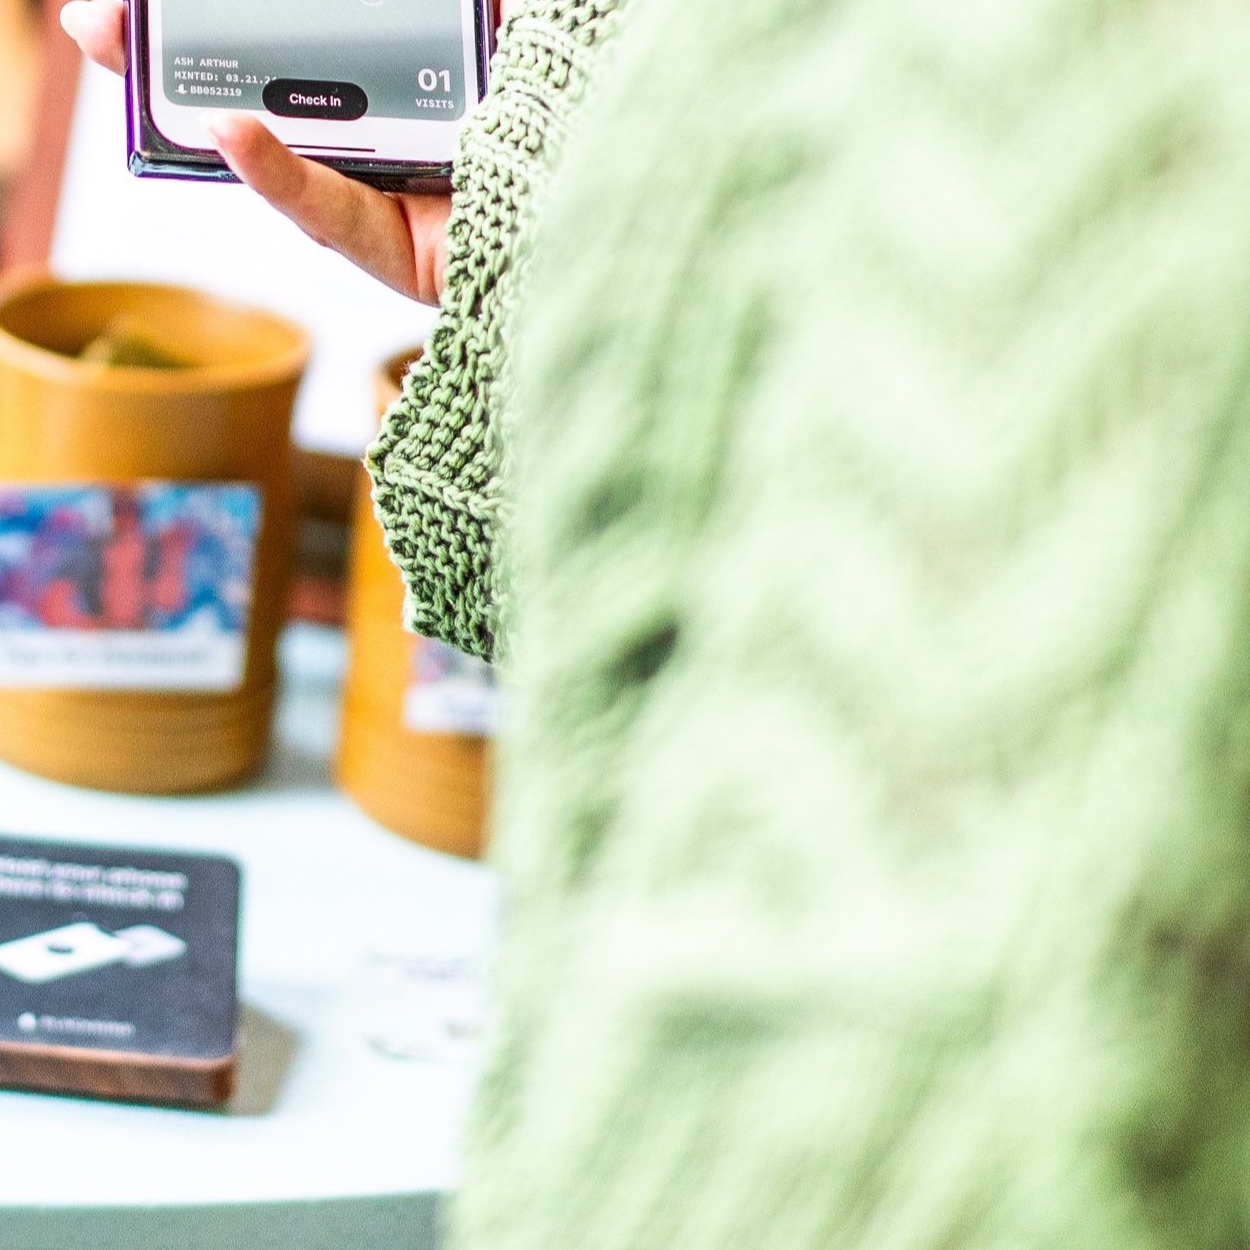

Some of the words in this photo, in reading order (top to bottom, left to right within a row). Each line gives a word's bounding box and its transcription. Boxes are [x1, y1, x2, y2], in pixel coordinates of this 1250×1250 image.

[174, 56, 194, 67] ASH
[199, 58, 239, 69] ARTHUR
[174, 71, 219, 82] MINTED:
[225, 74, 277, 84] 03.21.2
[418, 68, 451, 92] 01
[190, 86, 242, 97] BB052319
[289, 93, 328, 106] Check
[330, 95, 342, 107] In
[415, 98, 454, 109] VISITS
